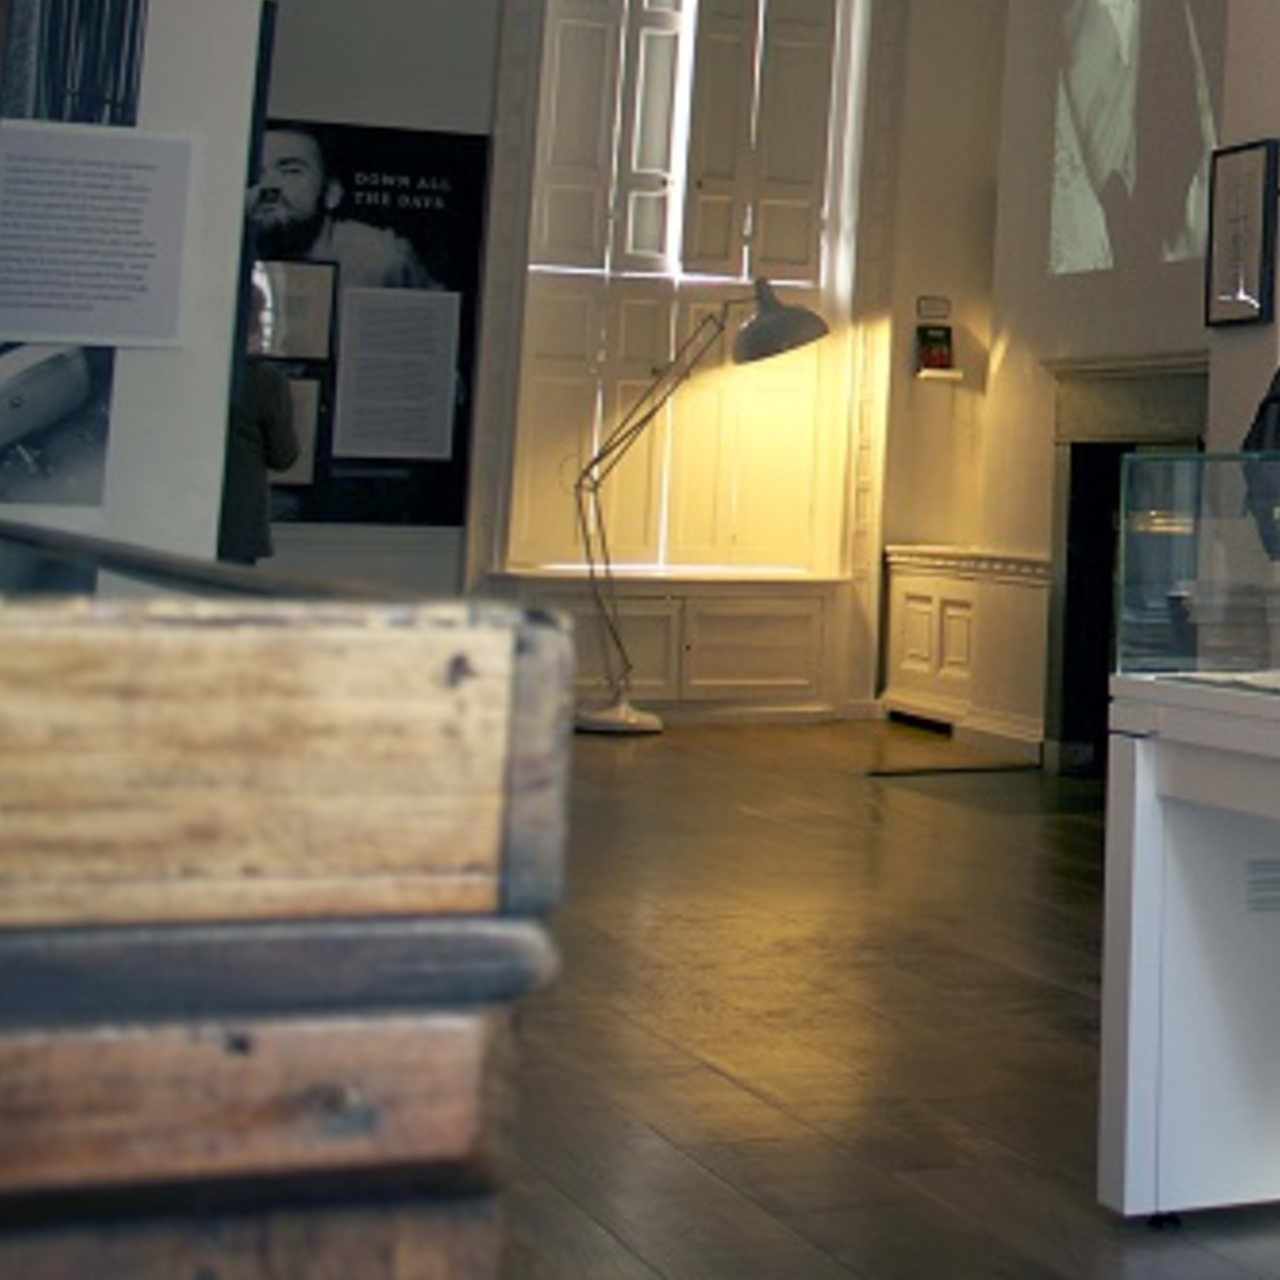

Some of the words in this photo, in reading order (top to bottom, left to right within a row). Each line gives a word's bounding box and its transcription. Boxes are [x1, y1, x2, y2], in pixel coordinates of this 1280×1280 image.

[354, 171, 411, 190] DOWN
[416, 175, 453, 193] ALL
[354, 191, 390, 208] THE
[397, 194, 445, 210] DAYS
